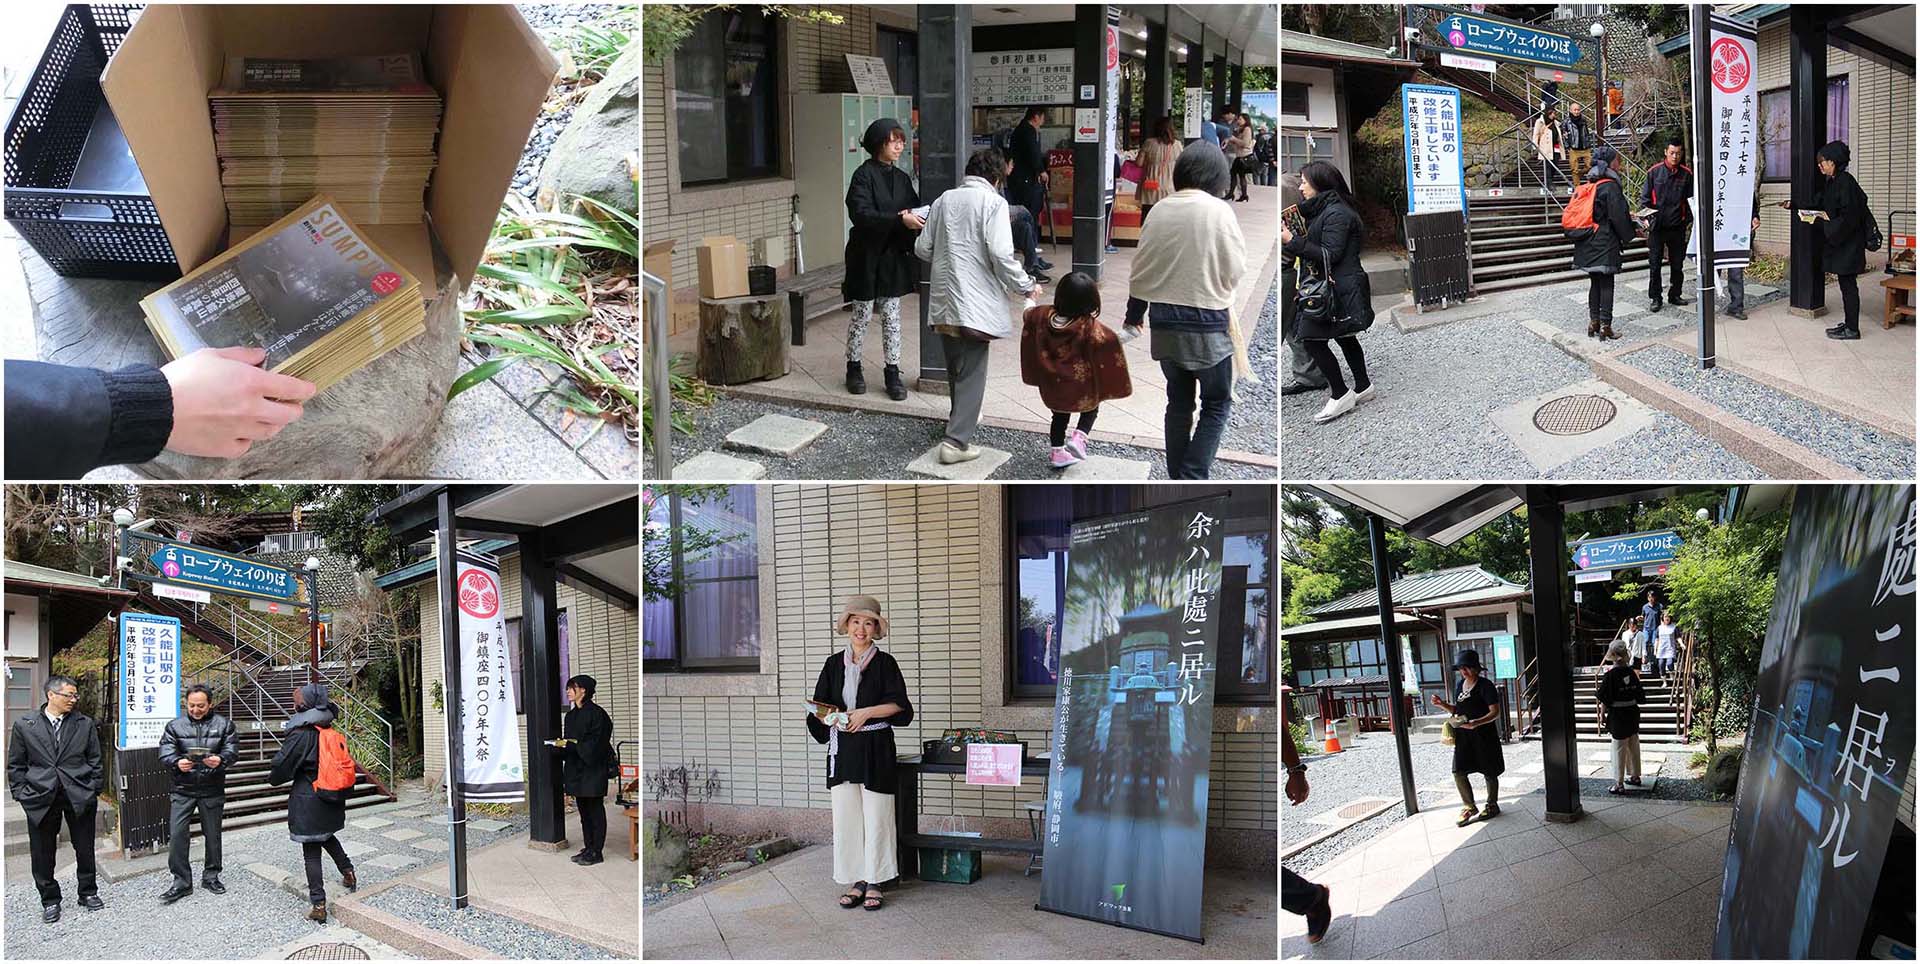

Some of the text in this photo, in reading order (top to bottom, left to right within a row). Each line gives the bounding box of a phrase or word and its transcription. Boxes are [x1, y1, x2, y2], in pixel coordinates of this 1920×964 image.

[1467, 23, 1571, 55] ロープウェイのりば
[1008, 76, 1031, 84] 500円
[1008, 85, 1031, 93] 200円
[1043, 75, 1067, 83] 800円
[1043, 84, 1067, 92] 300円
[1408, 97, 1421, 179] 平成27年3月31日まで
[1423, 97, 1441, 181] 改修工事しています
[1440, 98, 1456, 154] 久能山駅の
[1736, 94, 1752, 177] 平成二十七年
[1591, 536, 1674, 557] ロープウェイのりば
[182, 553, 287, 587] ロープウェイのりば
[126, 626, 137, 711] 平成27年3月31日まで
[142, 627, 157, 714] 改修工事しています
[160, 628, 174, 685] 久能山駅の
